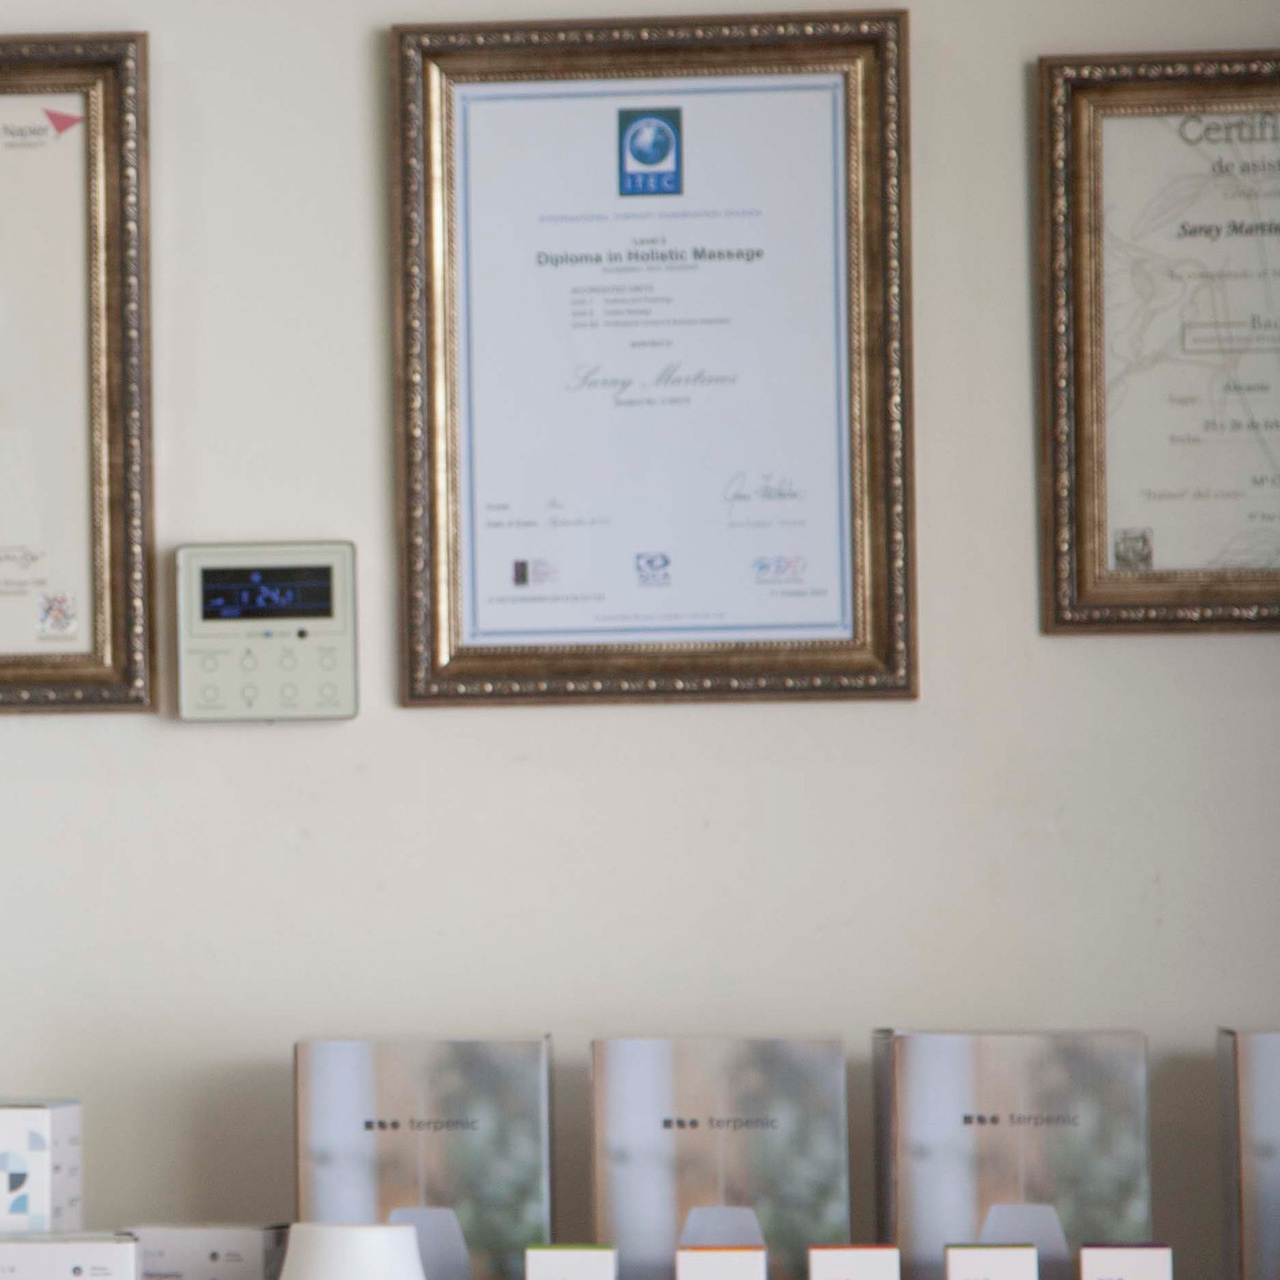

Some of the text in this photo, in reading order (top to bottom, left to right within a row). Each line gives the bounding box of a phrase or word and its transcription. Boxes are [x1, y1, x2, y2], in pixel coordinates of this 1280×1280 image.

[624, 175, 677, 194] ITEC
[535, 245, 765, 268] Diploma in Holistic Massage
[408, 1116, 480, 1132] terpenic
[707, 1114, 780, 1131] terpenic
[1007, 1111, 1080, 1128] terpenic
